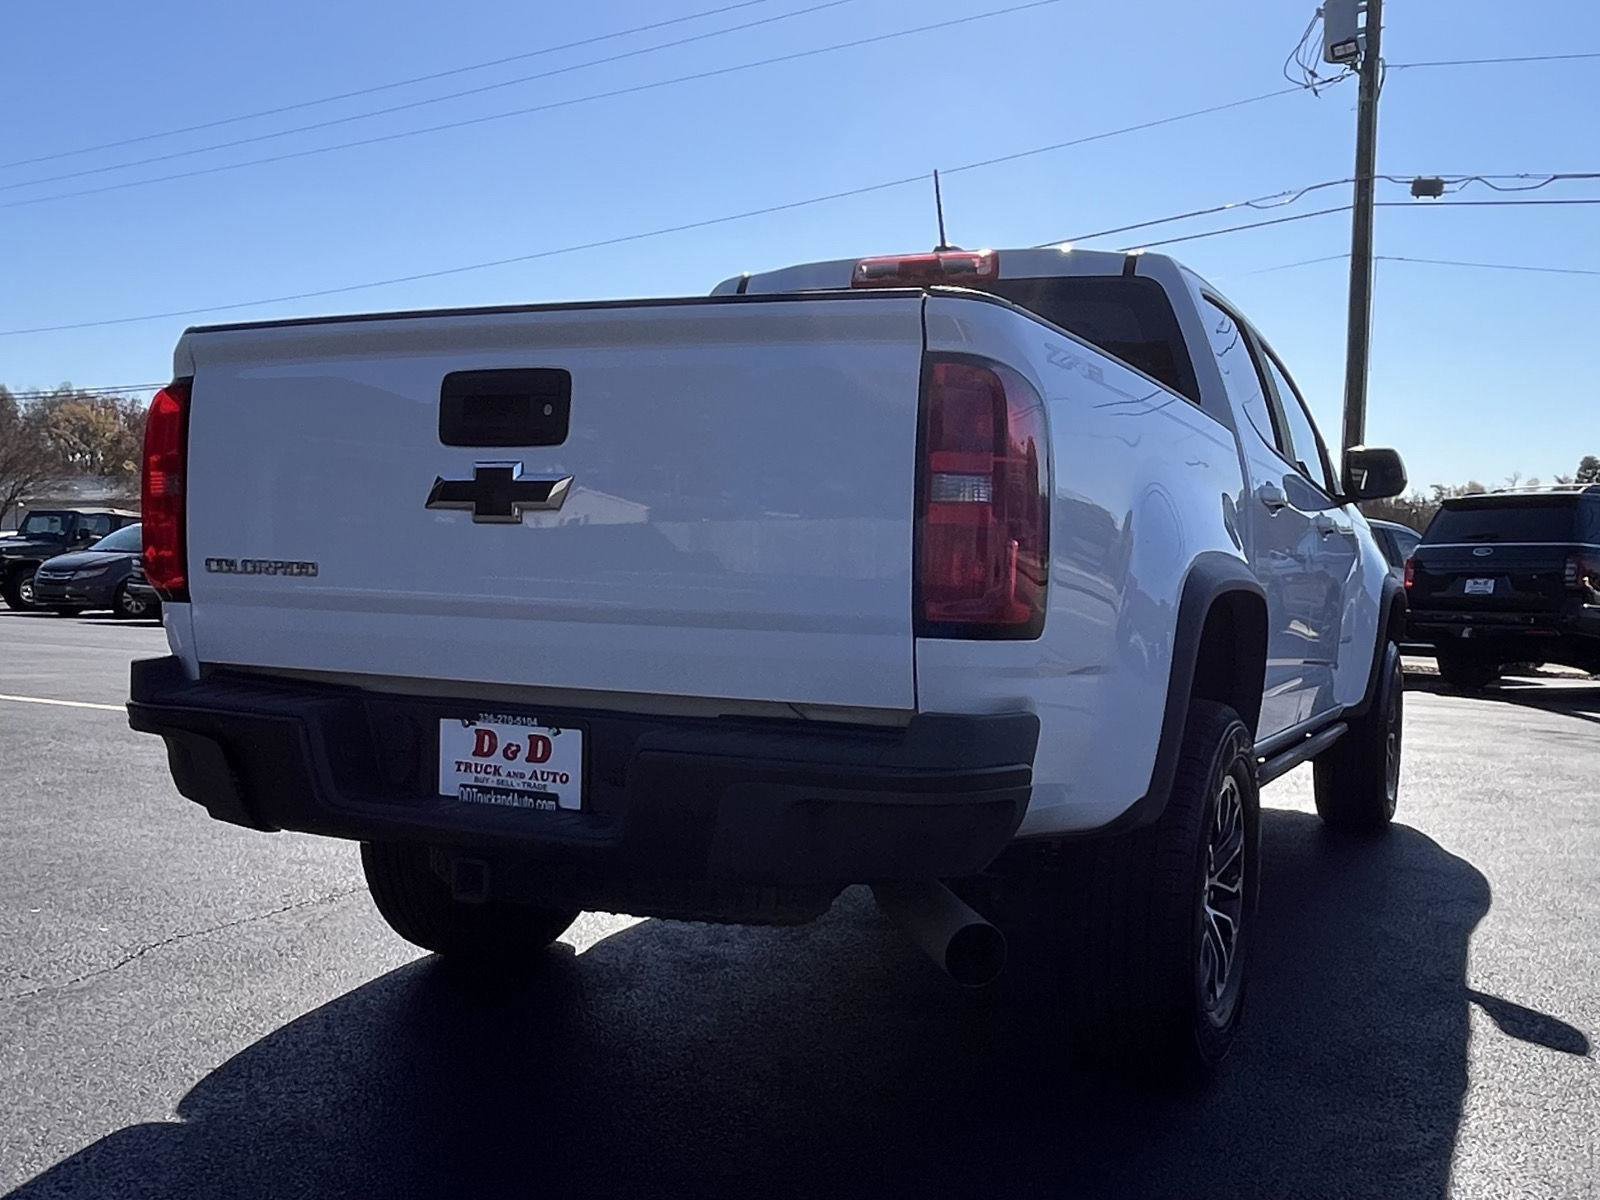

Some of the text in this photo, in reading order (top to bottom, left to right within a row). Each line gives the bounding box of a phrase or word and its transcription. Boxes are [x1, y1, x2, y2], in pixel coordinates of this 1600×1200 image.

[205, 557, 318, 577] COLORADO
[472, 728, 552, 764] D & D
[455, 761, 570, 785] TRUCK AND AUTO
[522, 781, 547, 791] TRADE
